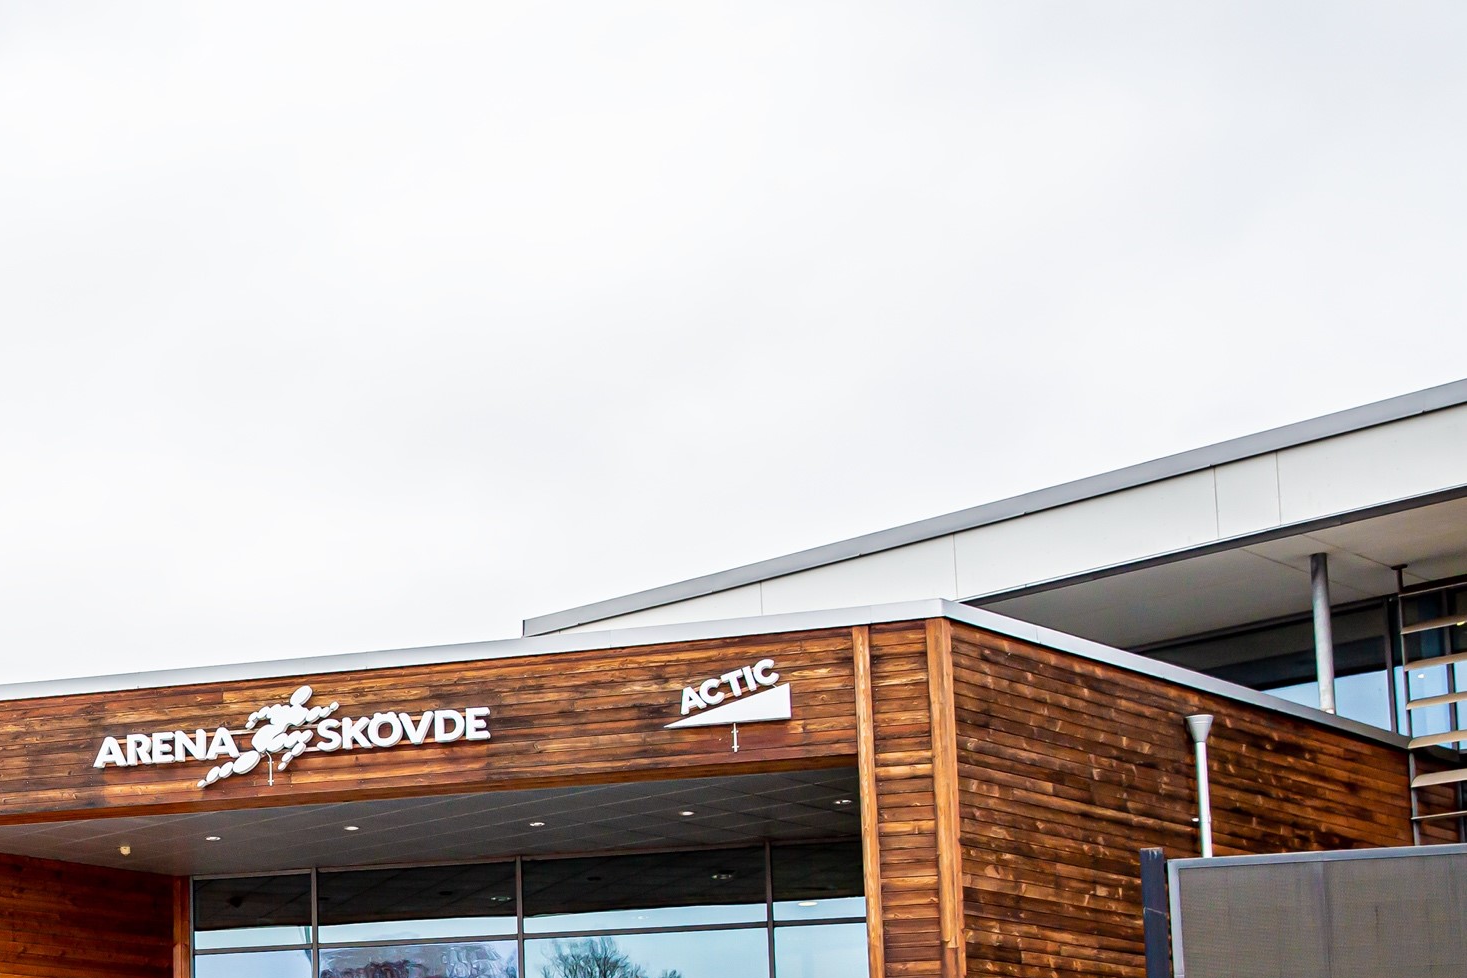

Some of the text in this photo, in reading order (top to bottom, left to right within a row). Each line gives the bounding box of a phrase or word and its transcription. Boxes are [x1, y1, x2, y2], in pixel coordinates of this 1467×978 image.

[680, 658, 780, 715] ACTIC
[93, 706, 491, 769] ARENA SKÖVDE
